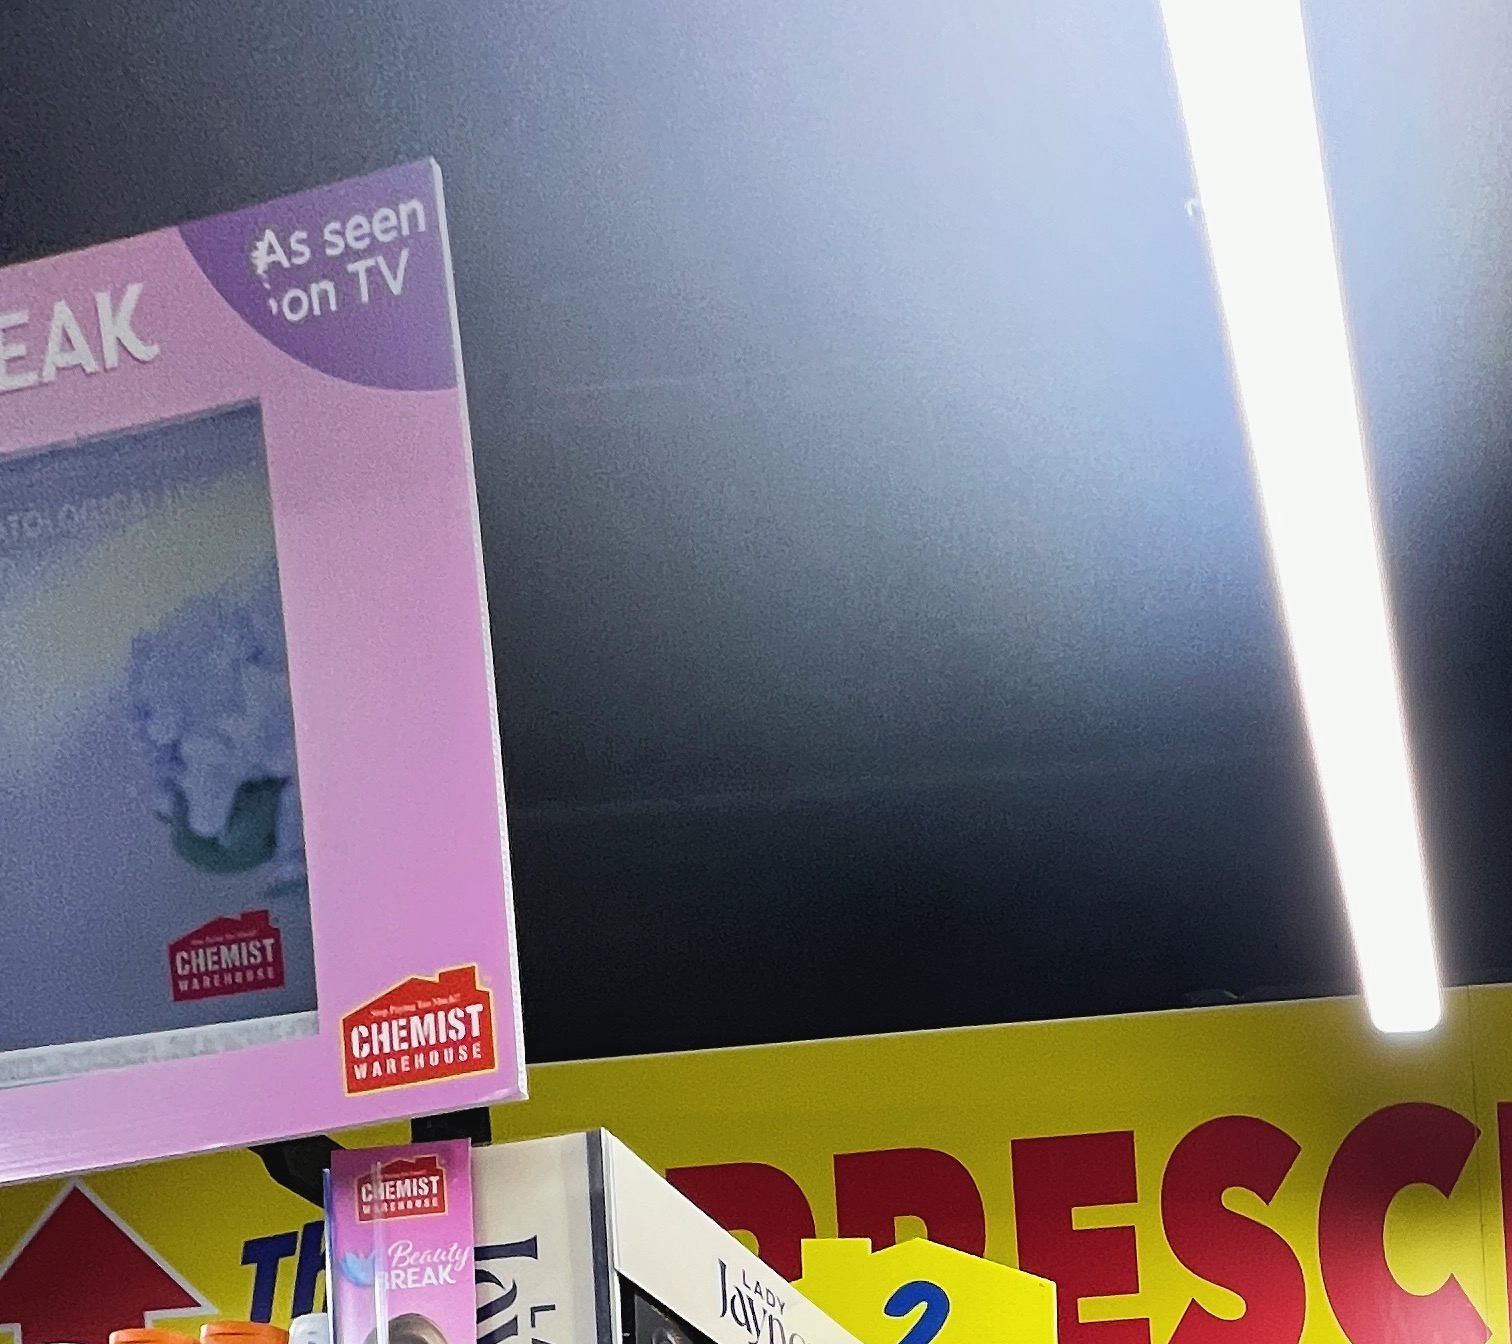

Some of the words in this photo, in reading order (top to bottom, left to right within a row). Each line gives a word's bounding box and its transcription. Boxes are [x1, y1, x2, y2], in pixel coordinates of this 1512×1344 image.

[256, 228, 310, 272] As
[324, 198, 426, 256] seen
[281, 286, 337, 323] on
[348, 248, 411, 303] TV
[175, 938, 275, 977] CHEMIST
[351, 1003, 485, 1058] CHEMIST
[353, 1042, 482, 1080] WAREHOUSE
[742, 1272, 786, 1315] LADY
